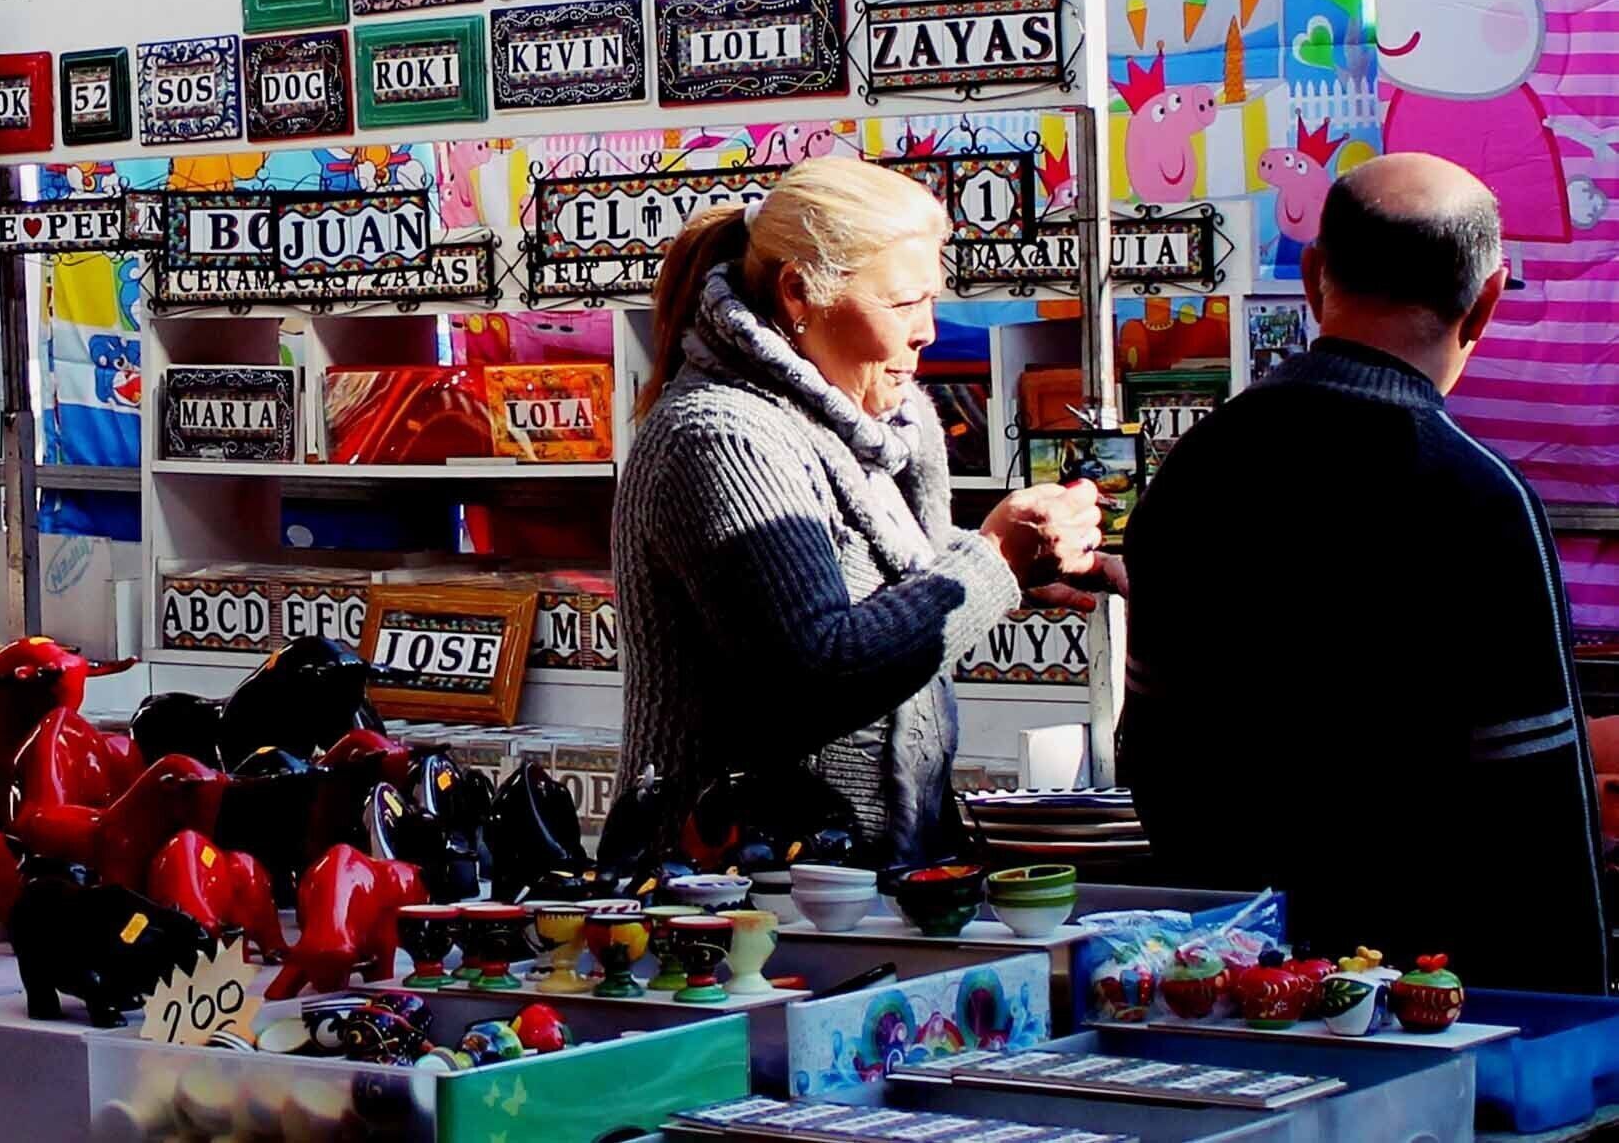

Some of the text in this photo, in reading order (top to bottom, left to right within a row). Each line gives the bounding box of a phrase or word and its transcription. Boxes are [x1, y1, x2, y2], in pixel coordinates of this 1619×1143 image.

[510, 36, 623, 75] KEVIN
[701, 28, 789, 64] LOLI
[872, 17, 1054, 71] ZAYAS
[158, 75, 214, 104] SOS
[264, 73, 323, 103] DOG
[376, 57, 455, 90] ROKI
[74, 86, 108, 112] 52
[977, 180, 997, 222] 1
[283, 213, 424, 261] JUAN
[576, 200, 630, 240] EL
[984, 236, 1178, 268] AXARUIA
[181, 400, 276, 429] MARIA
[506, 400, 592, 429] LOLA
[164, 595, 365, 638] ABCD EFG
[380, 632, 497, 675] JOSE
[963, 623, 1089, 664] WYX
